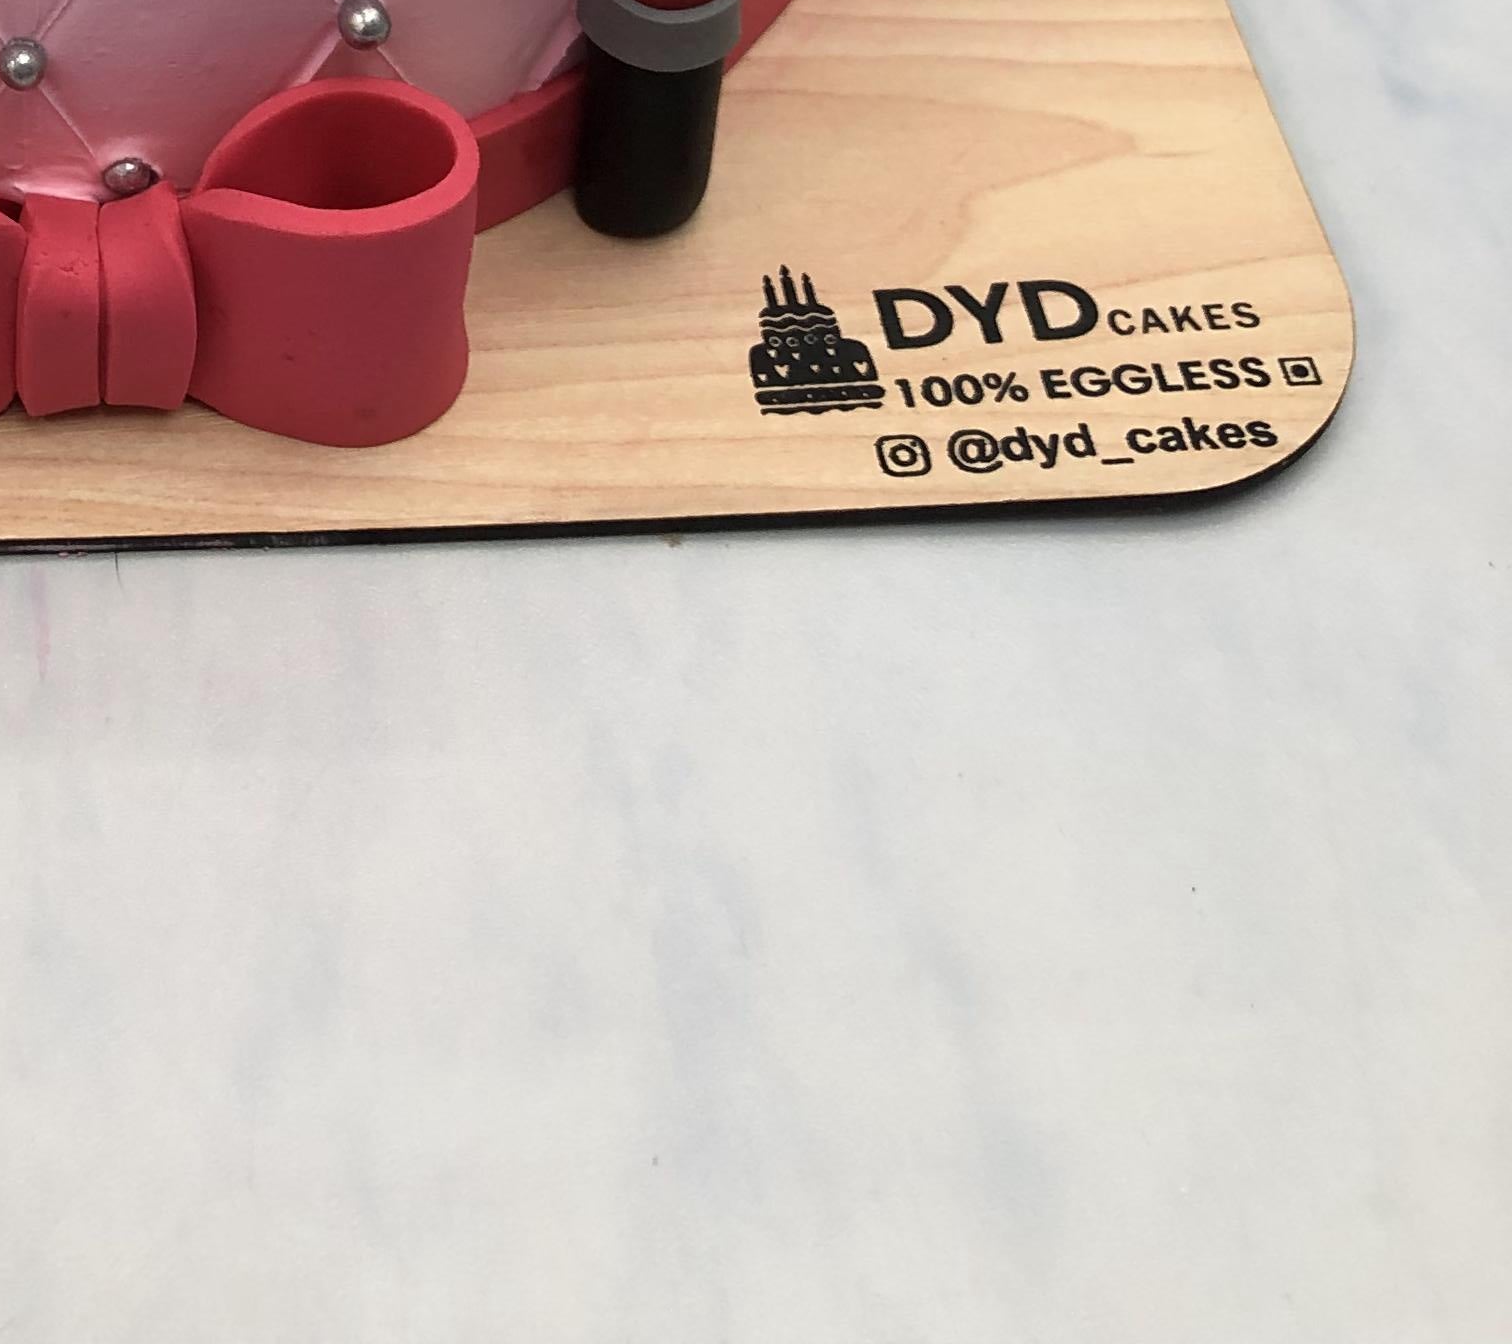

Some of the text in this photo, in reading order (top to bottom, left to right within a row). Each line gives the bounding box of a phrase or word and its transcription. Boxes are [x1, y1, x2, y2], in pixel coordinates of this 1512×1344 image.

[873, 280, 1261, 350] DYD CAKES
[894, 357, 1271, 408] 100% EGGLESS
[947, 415, 1278, 474] @dyd_cakes
